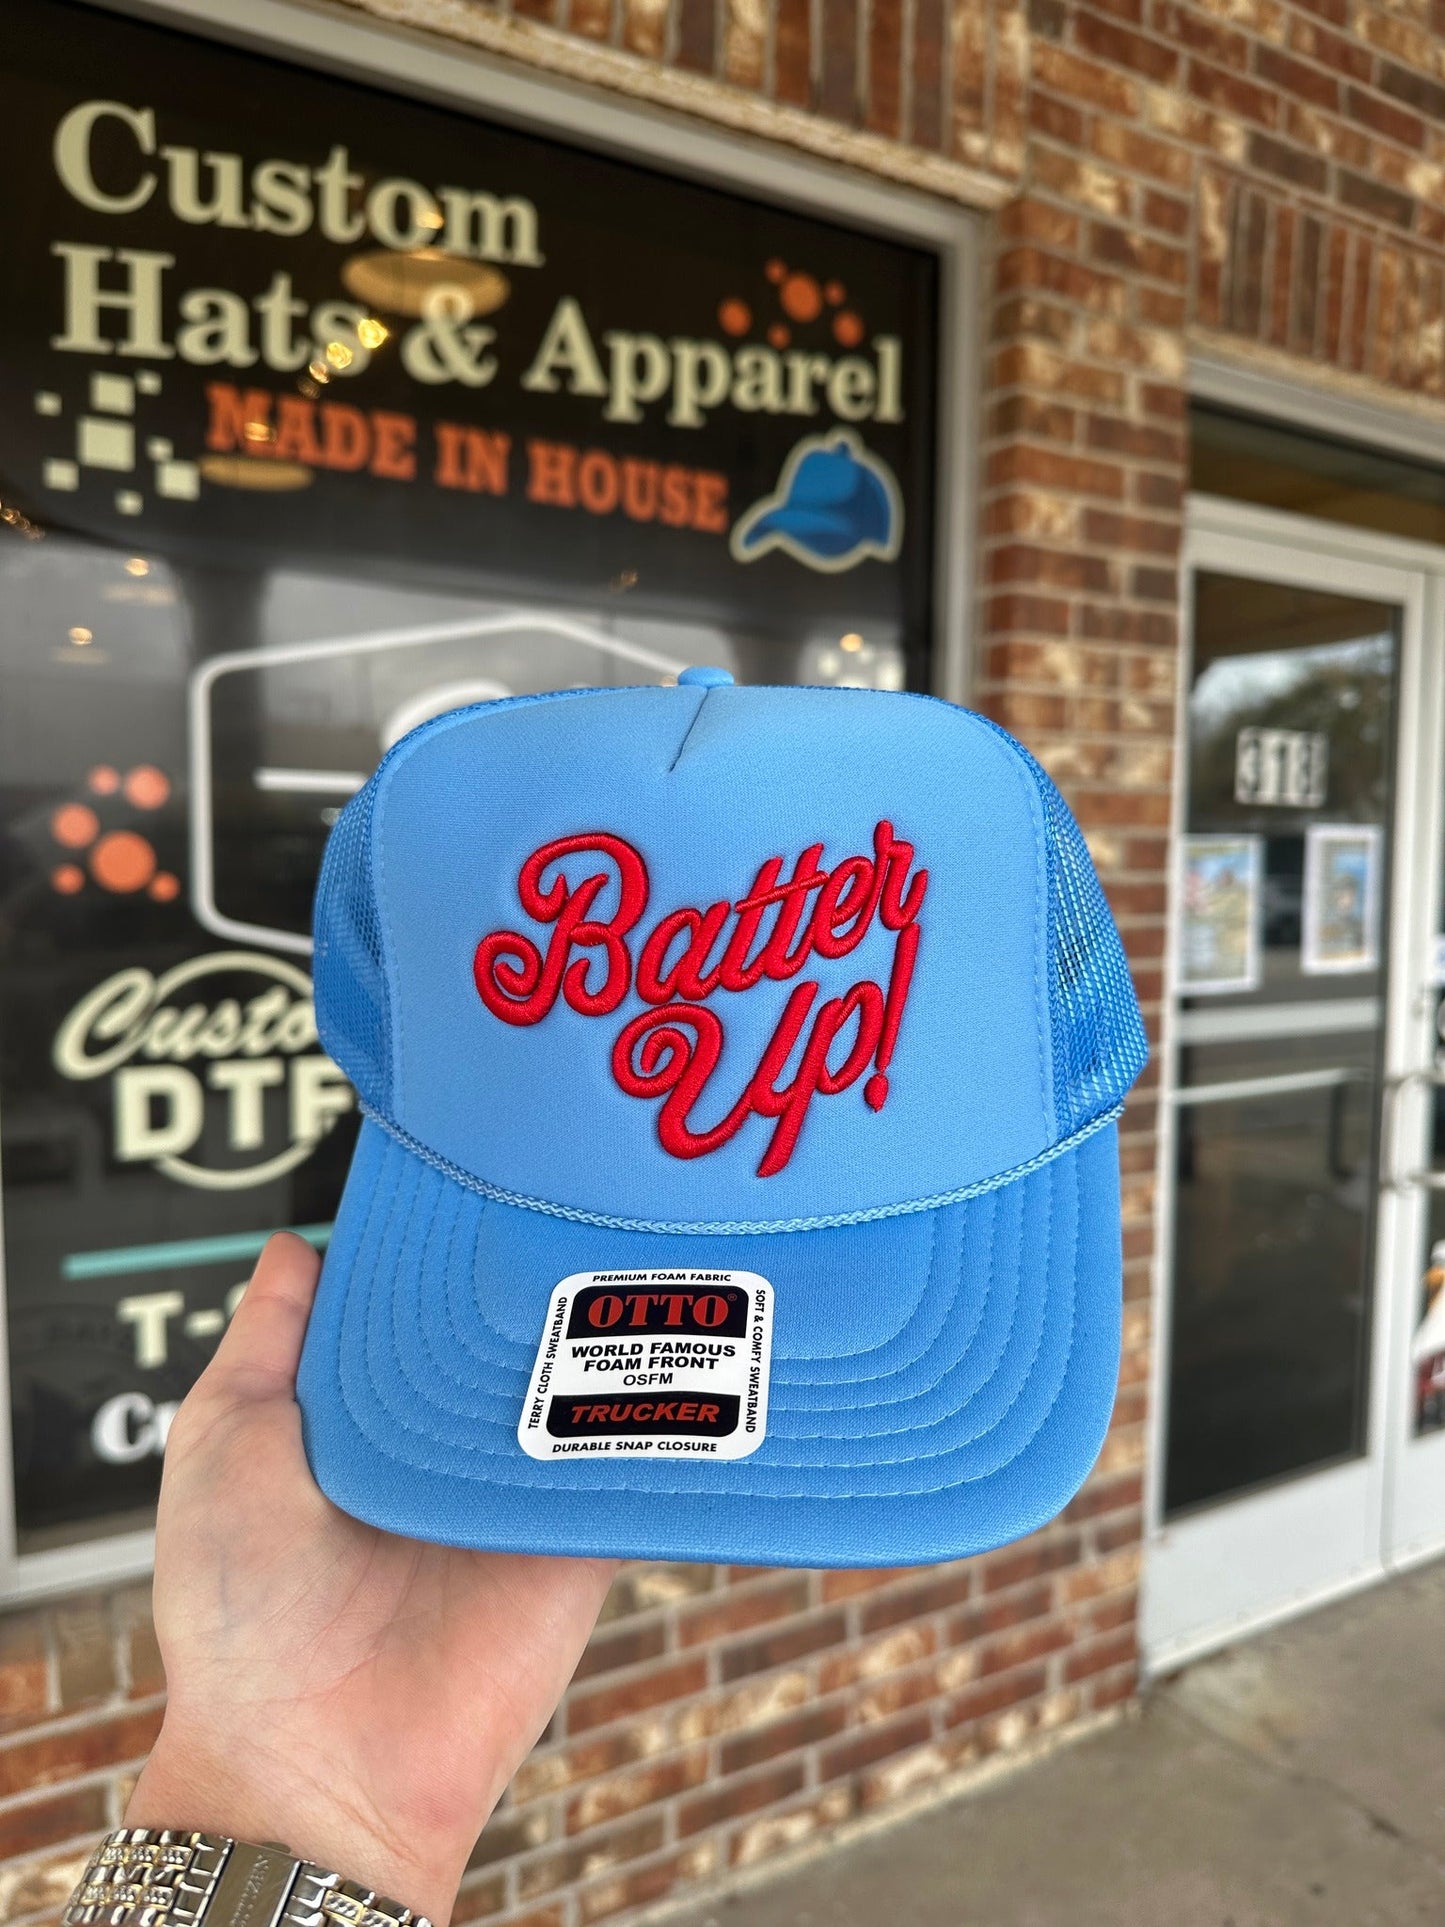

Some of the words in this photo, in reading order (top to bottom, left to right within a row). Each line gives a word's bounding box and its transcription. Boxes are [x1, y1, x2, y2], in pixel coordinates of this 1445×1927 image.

[53, 99, 546, 267] Custom
[50, 241, 374, 376] Hats
[401, 282, 498, 387] &
[520, 296, 905, 428] Apparel
[206, 382, 417, 480] MADE
[435, 422, 511, 496] IN
[526, 437, 730, 534] HOUSE
[473, 819, 928, 1026] Batter
[53, 967, 317, 1080] Custo
[611, 923, 921, 1178] Up!
[113, 1054, 354, 1163] DTF
[592, 1274, 647, 1282] PREMIUM
[651, 1273, 686, 1281] FOAM
[690, 1273, 732, 1282] FABRIC
[755, 1289, 766, 1312] SOFT
[528, 1397, 545, 1429] TERRY
[537, 1362, 554, 1394] CLOTH
[546, 1296, 568, 1359] SWEATBAND
[572, 1343, 644, 1358] WORLD
[650, 1342, 736, 1357] FAMOUS
[583, 1357, 642, 1372] FOAM
[648, 1356, 719, 1370] FRONT
[751, 1326, 763, 1363] COMFY
[623, 1372, 673, 1386] OSFM
[745, 1366, 760, 1433] SWEATBAND
[571, 1402, 720, 1424] TRUCKER
[552, 1441, 611, 1453] DURABLE
[615, 1441, 653, 1451] SNAP
[657, 1441, 717, 1452] CLOSURE
